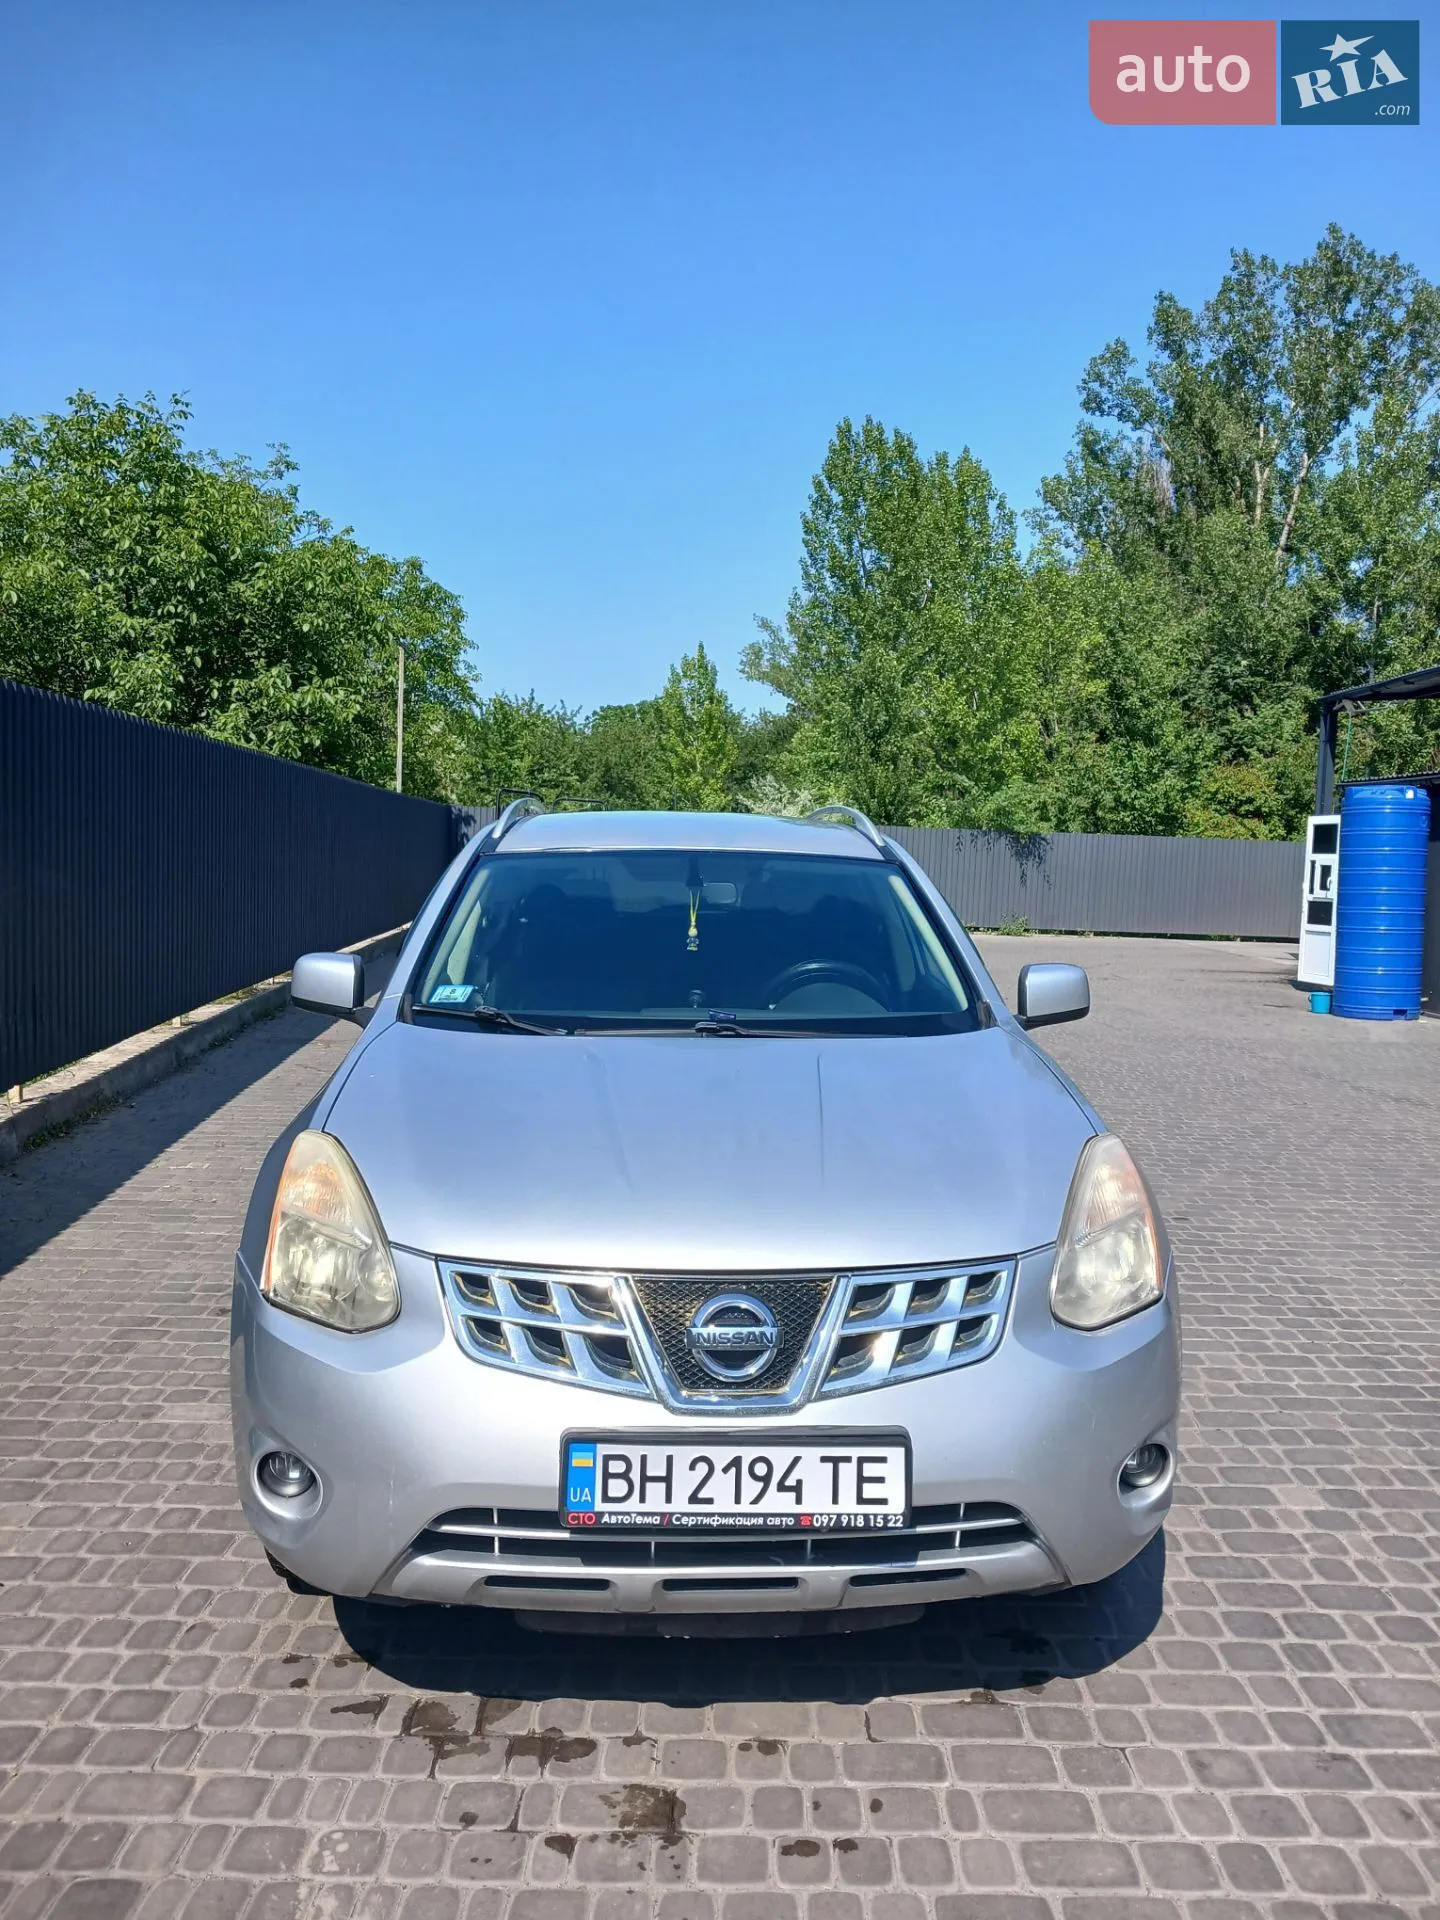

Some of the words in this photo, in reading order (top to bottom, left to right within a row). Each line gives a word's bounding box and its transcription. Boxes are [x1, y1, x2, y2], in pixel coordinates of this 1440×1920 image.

[694, 1330, 774, 1347] NISSAN
[601, 1453, 674, 1504] BH
[687, 1454, 803, 1505] 2194
[819, 1455, 889, 1506] TE
[569, 1487, 592, 1503] UA
[567, 1512, 596, 1525] СТО
[601, 1513, 661, 1525] АвтоТема
[672, 1513, 763, 1527] Сертификация
[767, 1515, 795, 1527] авто
[813, 1514, 837, 1527] 097
[841, 1514, 864, 1527] 918
[869, 1514, 884, 1527] 15
[887, 1514, 904, 1527] 22
